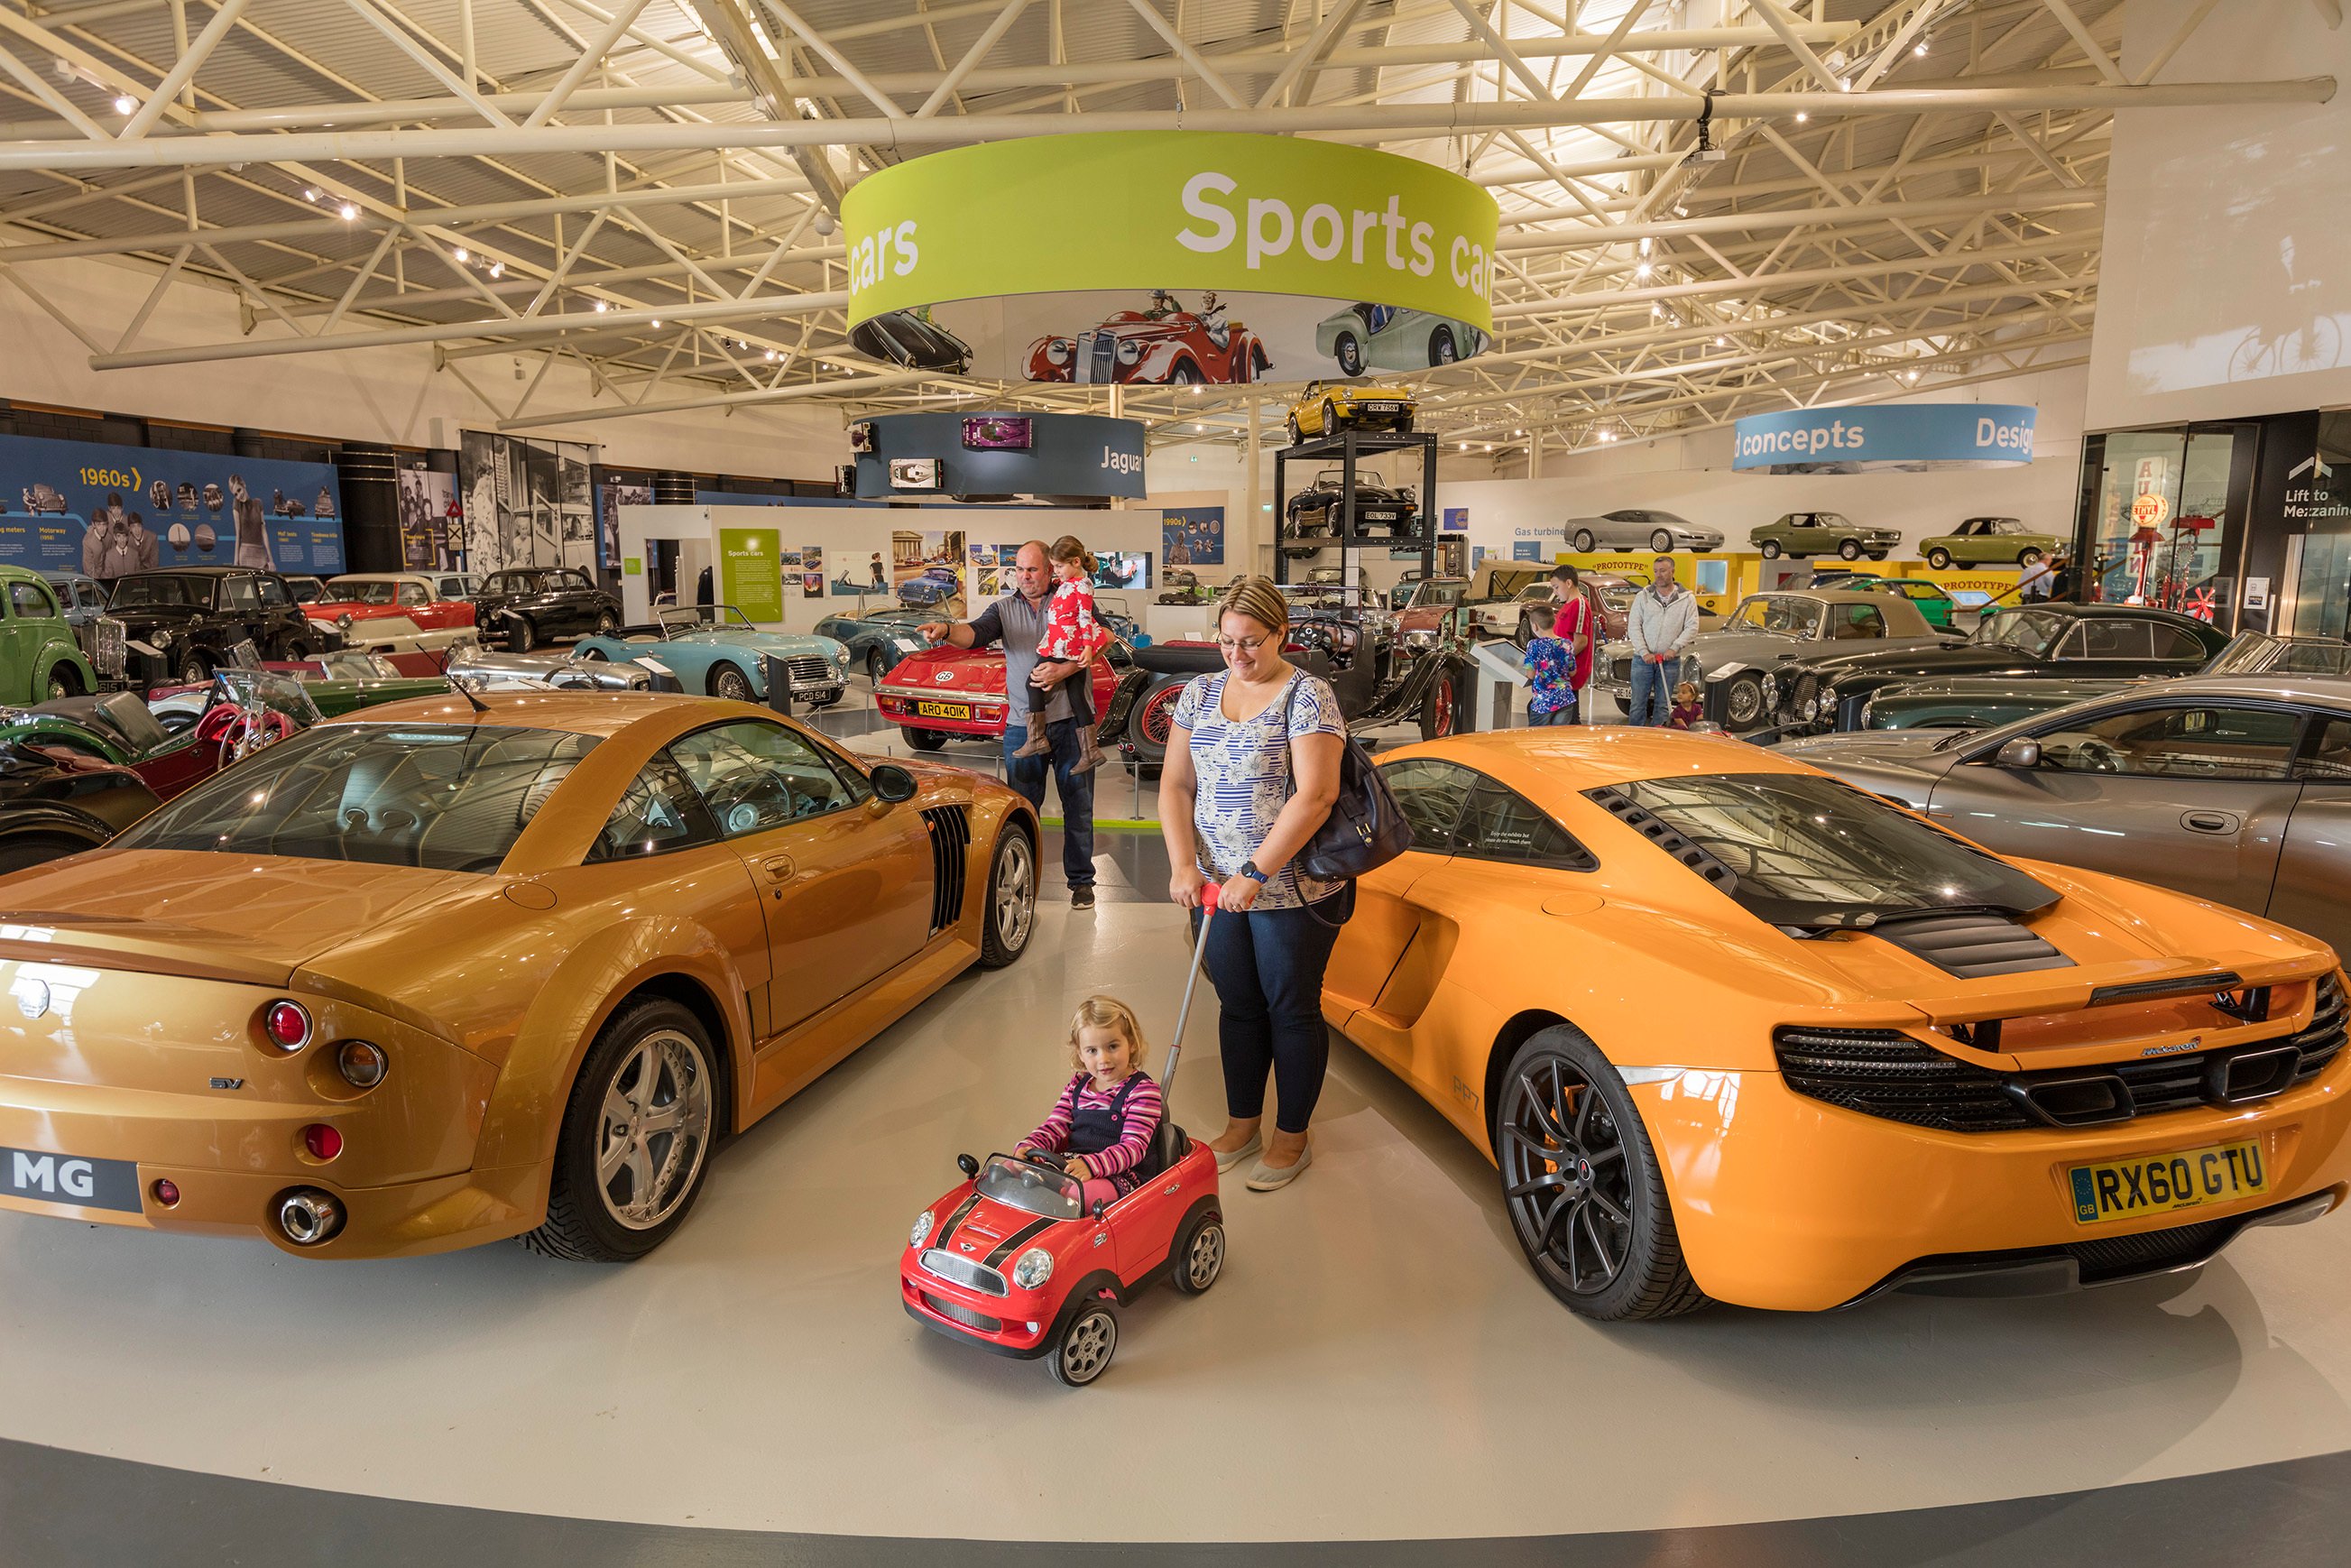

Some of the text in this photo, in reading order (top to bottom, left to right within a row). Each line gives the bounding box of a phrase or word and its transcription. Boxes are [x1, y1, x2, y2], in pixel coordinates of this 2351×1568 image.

[1176, 171, 1494, 303] Sports car
[851, 220, 918, 296] cars
[1743, 420, 1865, 456] concepts
[1976, 418, 2033, 455] Desig
[1102, 446, 1142, 475] Jaguar
[79, 467, 131, 488] 1960s
[2285, 489, 2329, 503] Lift to
[2132, 505, 2157, 515] ETHYL
[1163, 518, 1182, 526] 1990s
[39, 527, 67, 535] Motorway
[1515, 527, 1565, 537] Gas turbine
[728, 549, 749, 558] Sports
[937, 672, 953, 680] GB
[99, 683, 117, 693] 615
[798, 691, 826, 702] PCD 514
[922, 704, 966, 718] ARO 401K
[2142, 1040, 2199, 1056] McLaren
[209, 1078, 244, 1090] SV
[14, 1151, 94, 1198] MG
[2096, 1145, 2263, 1213] RX60 GTU
[2079, 1204, 2096, 1215] GB
